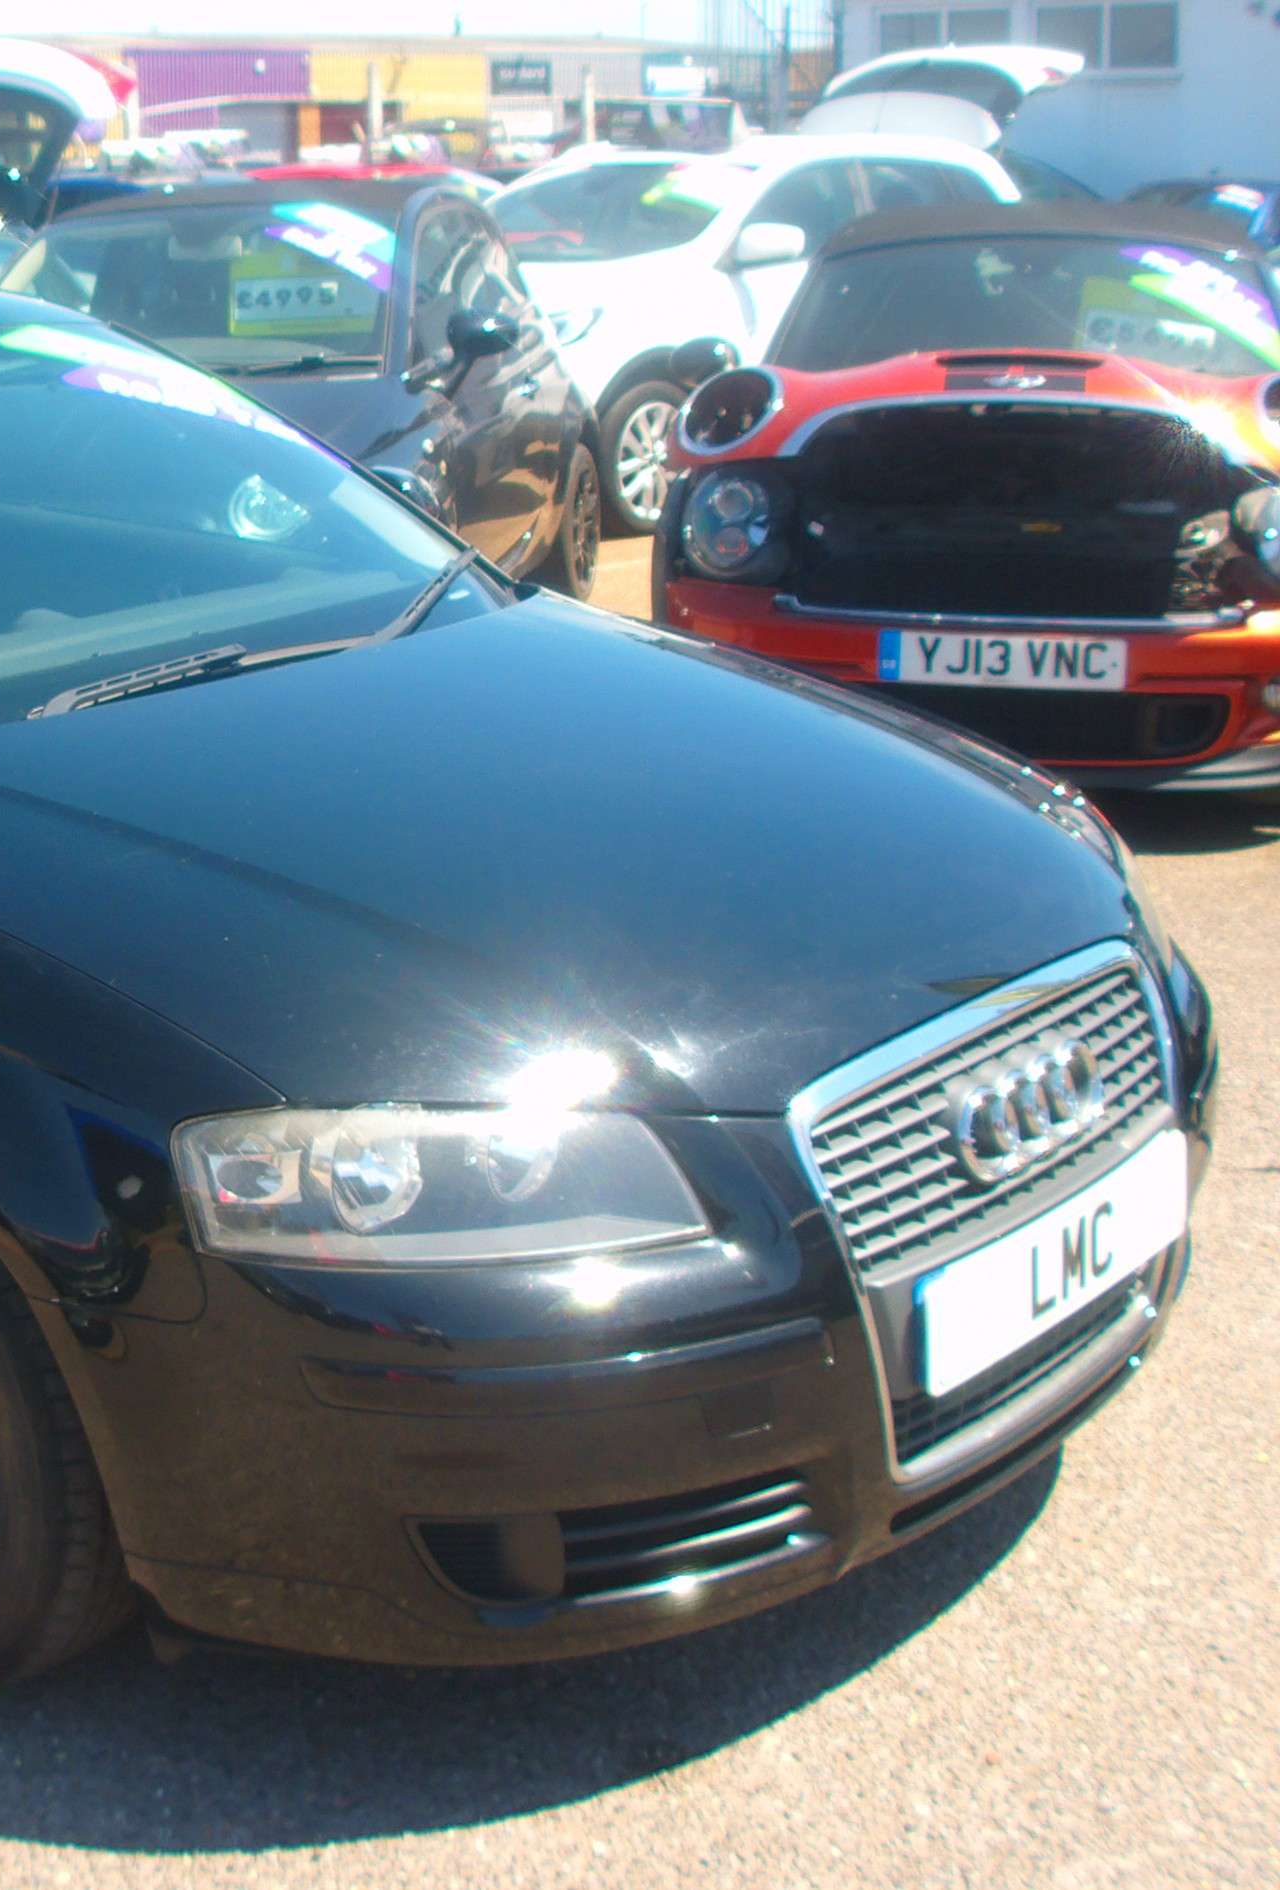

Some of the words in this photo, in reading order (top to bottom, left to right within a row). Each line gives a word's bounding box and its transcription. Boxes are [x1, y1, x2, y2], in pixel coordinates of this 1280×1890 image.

[236, 284, 336, 309] £4995
[918, 636, 1012, 676] YJ13
[1026, 639, 1109, 680] VNC
[1031, 1201, 1113, 1321] LMC
